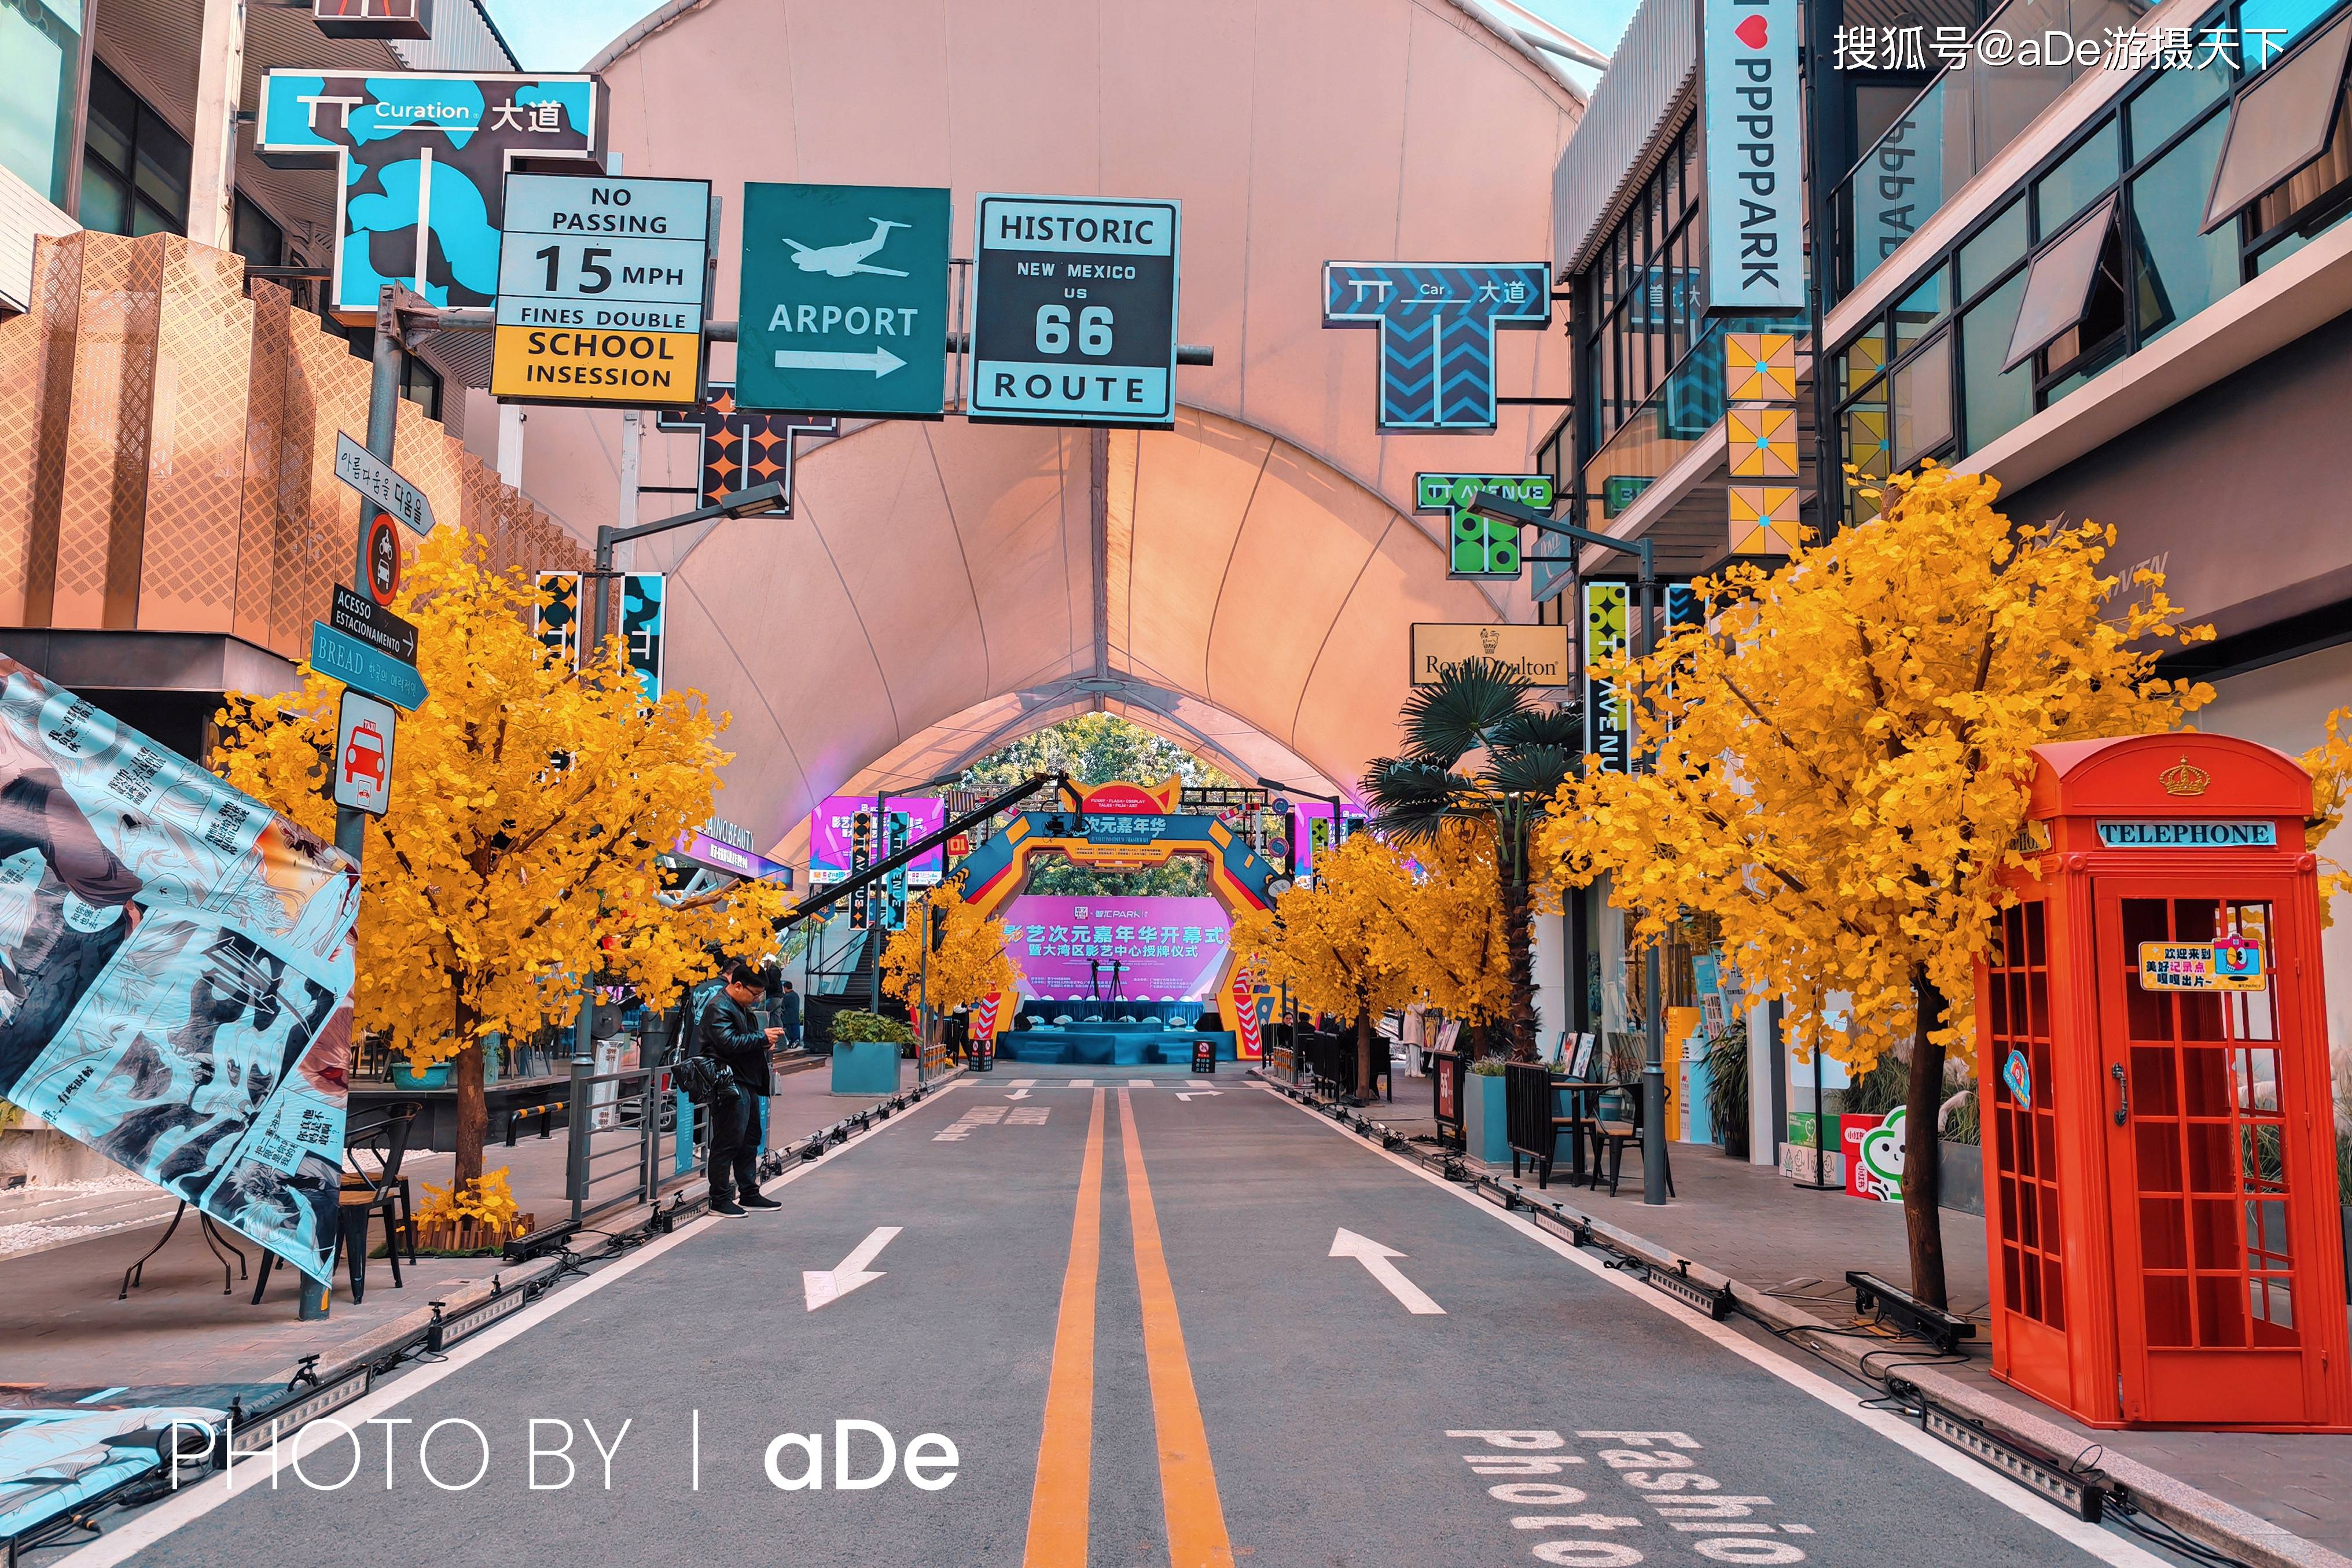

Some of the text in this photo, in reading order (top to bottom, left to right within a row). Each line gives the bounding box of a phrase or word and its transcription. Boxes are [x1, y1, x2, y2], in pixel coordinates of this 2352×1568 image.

[375, 101, 470, 120] Curation
[491, 98, 561, 134] 大道
[1734, 58, 1779, 290] PPPPPARK
[591, 187, 631, 207] NO
[552, 212, 668, 234] PASSING
[1001, 215, 1154, 245] HISTORIC
[536, 245, 683, 295] 15 MPH
[1017, 262, 1136, 280] NEW MEXICO
[1064, 288, 1087, 300] US
[1420, 283, 1445, 296] Car
[1478, 280, 1526, 304] 大道
[521, 307, 686, 329] FINES DOUBLE
[767, 304, 918, 337] ARPORT
[1035, 304, 1114, 356] 66
[528, 332, 674, 360] SCHOOL
[526, 364, 671, 388] INSESSION
[994, 373, 1144, 404] ROUTE
[337, 590, 372, 620] ACESSO
[336, 609, 400, 653] ESTACIONAMENTO
[318, 636, 363, 675] BREAD
[365, 720, 376, 731] TAXI
[1598, 679, 1619, 773] AVENU
[2100, 824, 2269, 844] TELEPHONE
[1004, 925, 1225, 945] 影艺次元嘉年华开幕式
[1028, 944, 1199, 958] 暨大湾区影艺中心授牌仪式
[2164, 948, 2211, 960] 欢迎来到
[2146, 960, 2205, 973] 美好记录点
[1443, 1430, 1644, 1567] Photo
